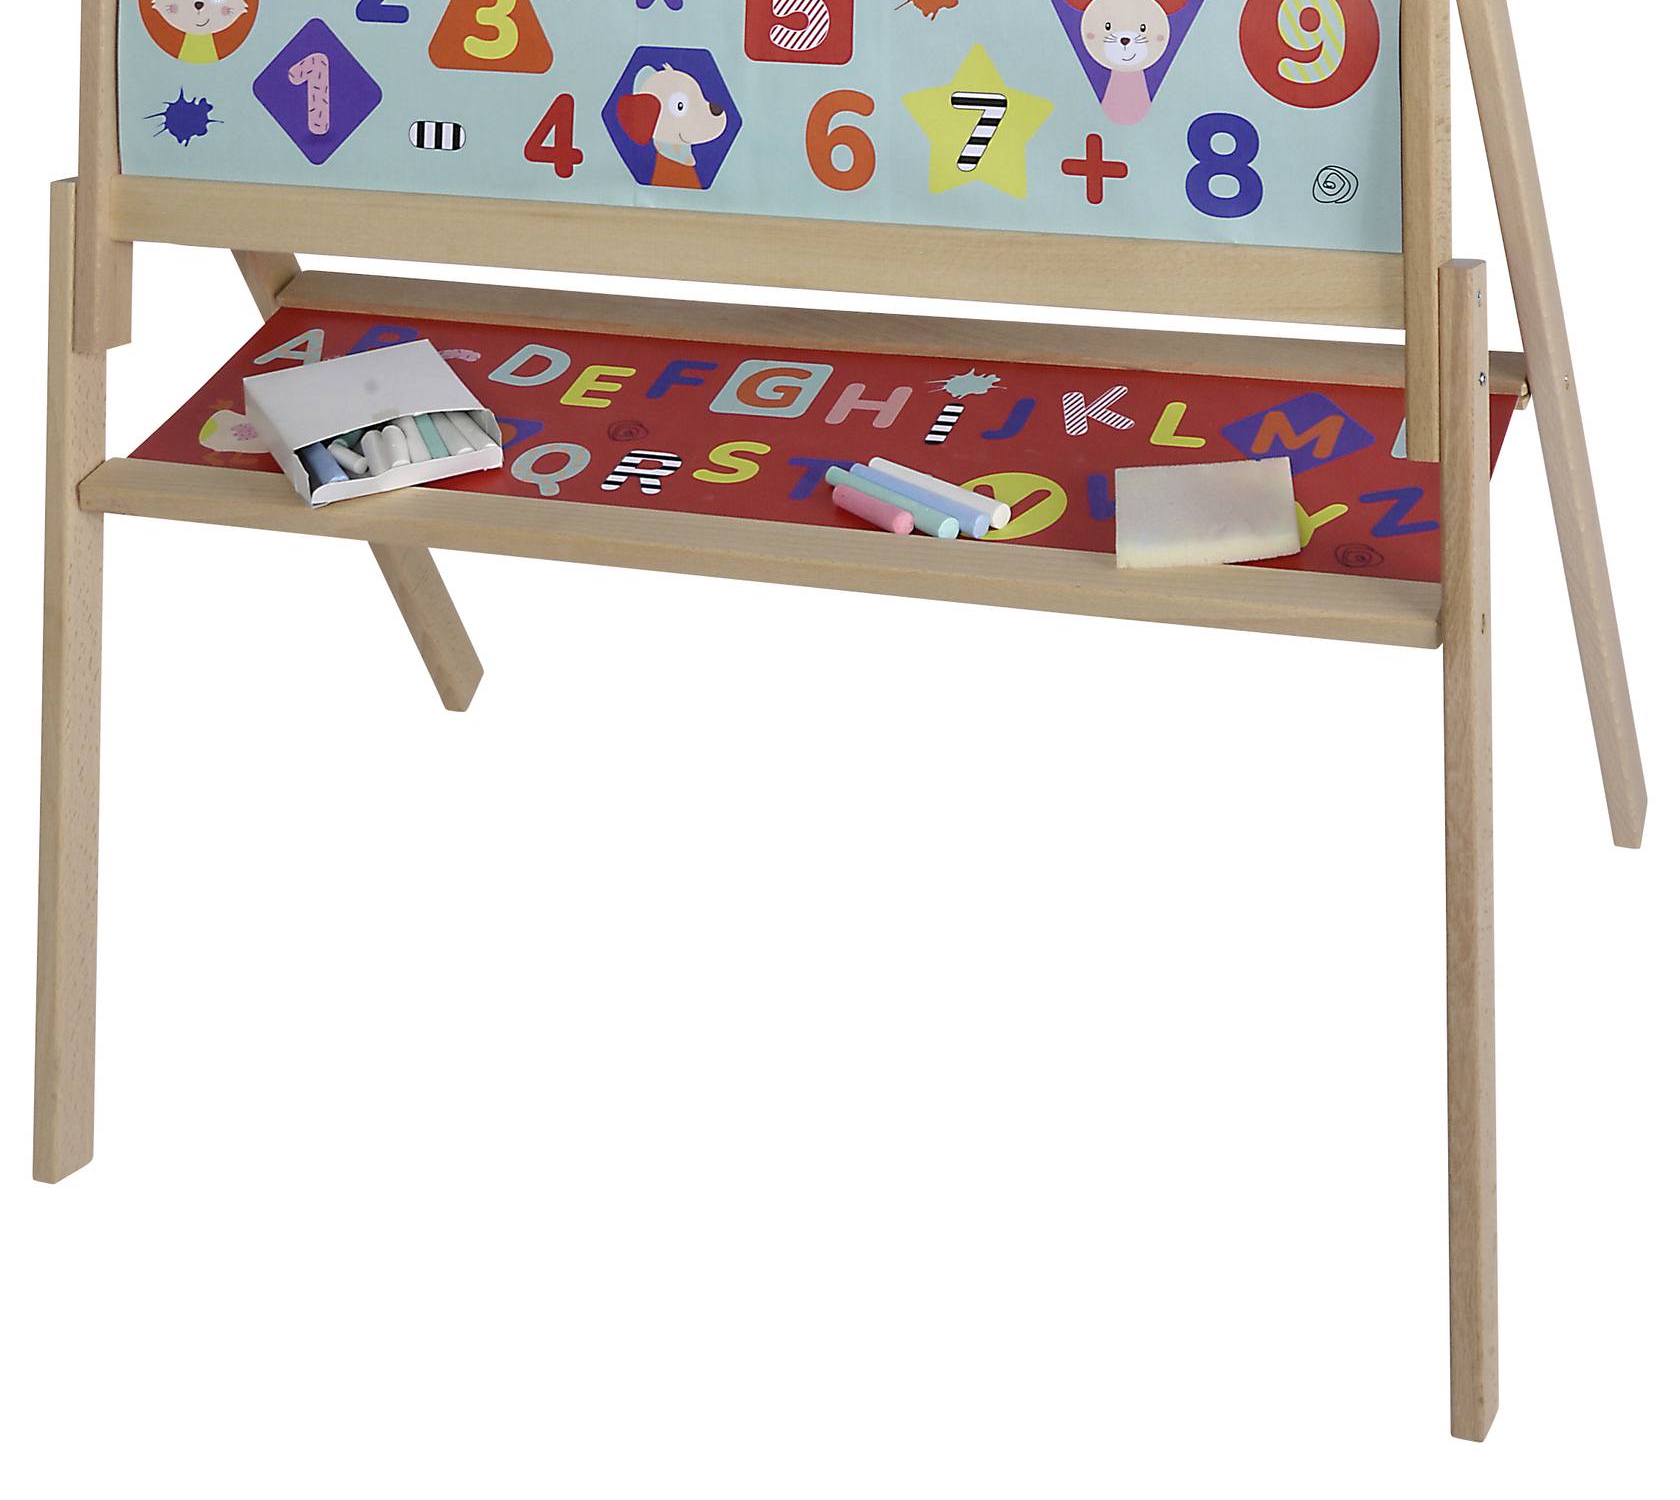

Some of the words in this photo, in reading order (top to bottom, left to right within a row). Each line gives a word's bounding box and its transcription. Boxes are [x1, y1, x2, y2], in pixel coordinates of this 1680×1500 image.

[287, 52, 330, 136] 1
[523, 92, 583, 179] 4
[805, 89, 877, 191] 6
[950, 91, 1008, 172] 7
[1185, 112, 1264, 218] 8
[253, 328, 325, 366] A
[488, 344, 571, 387] D
[560, 365, 636, 408] E
[646, 360, 718, 399] F
[736, 368, 811, 409] G
[824, 383, 912, 428] H
[981, 398, 1036, 440] J
[1062, 385, 1135, 436] K
[1149, 401, 1206, 448] L
[1251, 411, 1345, 458] M
[510, 442, 592, 497] Q
[600, 449, 682, 495] R
[692, 441, 771, 484] S
[788, 457, 857, 500] T
[1359, 487, 1440, 538] Z
